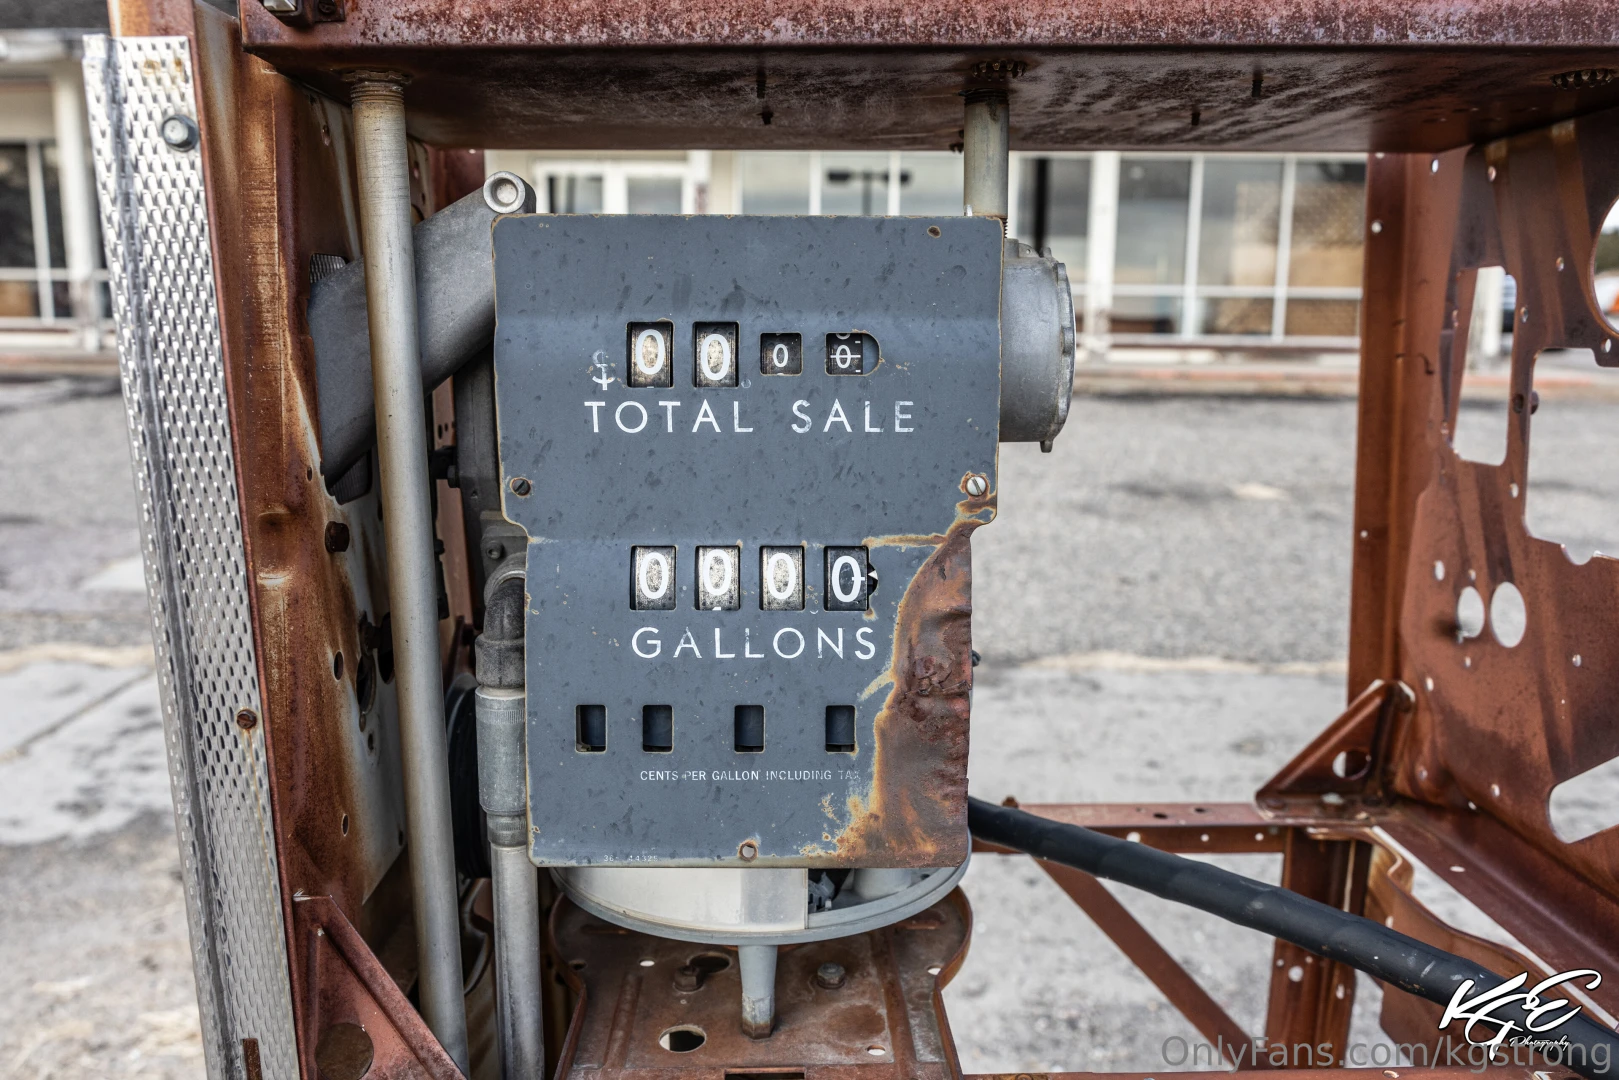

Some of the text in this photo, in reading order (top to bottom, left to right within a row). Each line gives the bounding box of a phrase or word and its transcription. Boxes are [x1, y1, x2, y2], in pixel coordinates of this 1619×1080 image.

[635, 329, 665, 375] 0
[700, 333, 731, 380] 0
[772, 343, 789, 368] 0
[584, 399, 914, 433] TOTAL SALE
[639, 552, 669, 600] 0
[703, 549, 732, 596] 0
[767, 552, 796, 600] 0
[631, 626, 876, 660] GALLONS
[640, 769, 861, 781] CENTS PER GALLON INCLUDING TAX
